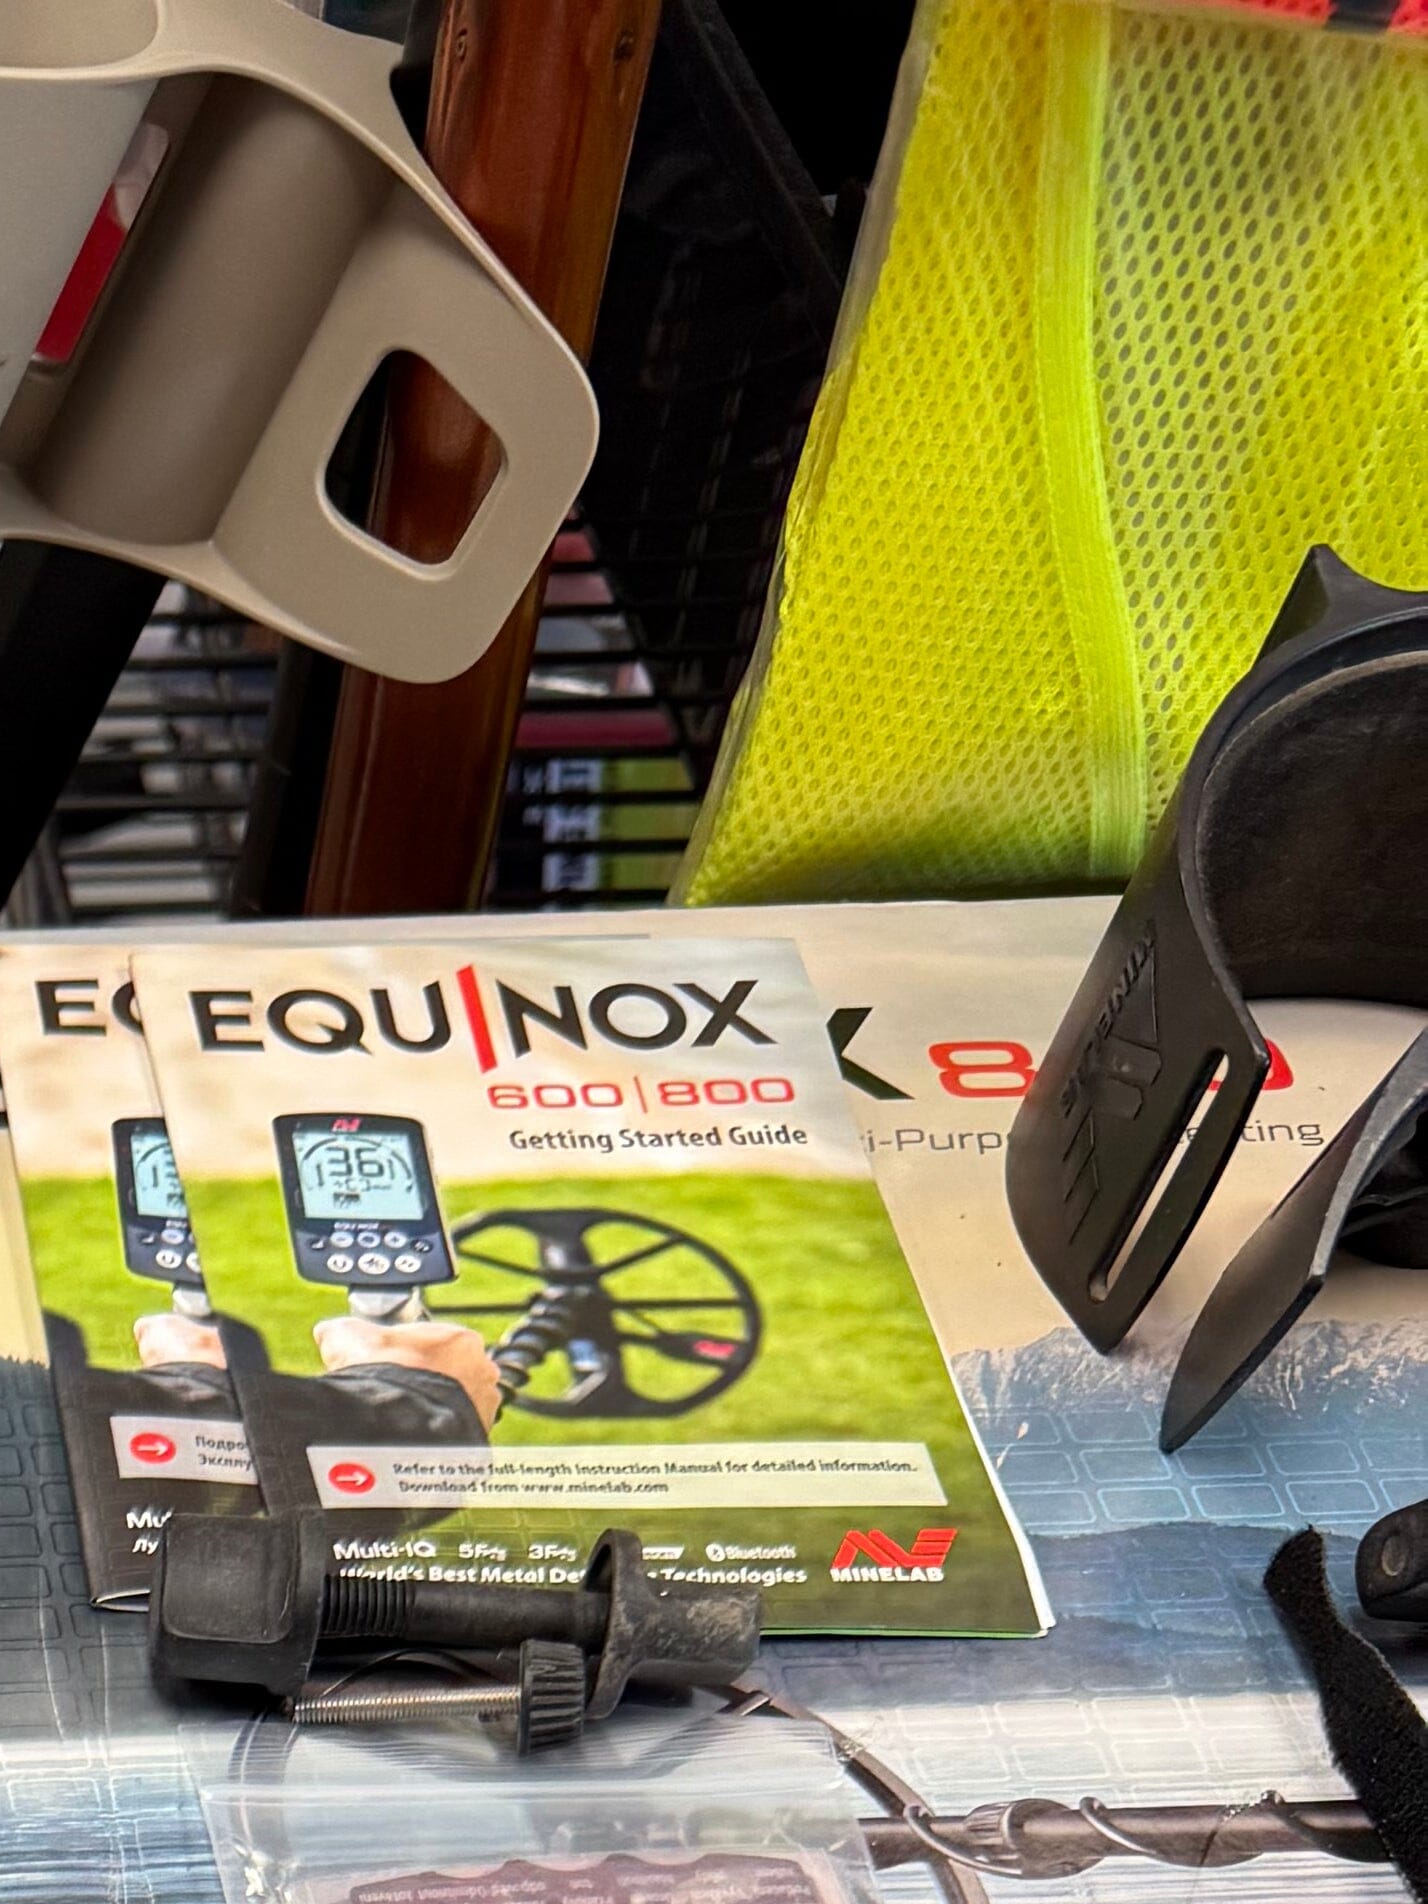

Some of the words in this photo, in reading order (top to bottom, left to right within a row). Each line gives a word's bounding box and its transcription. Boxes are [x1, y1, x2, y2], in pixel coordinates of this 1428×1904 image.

[189, 964, 778, 1074] EQUINOX
[509, 1129, 614, 1153] Getting
[619, 1127, 721, 1149] Started
[728, 1124, 808, 1146] Guide
[393, 1463, 435, 1475] Refer
[438, 1464, 456, 1475] to
[458, 1463, 485, 1475] the
[488, 1462, 572, 1478] full-length
[575, 1461, 661, 1475] Instruction
[664, 1460, 724, 1475] Manual
[726, 1460, 749, 1474] for
[752, 1459, 817, 1474] detailed
[819, 1457, 918, 1473] information.
[398, 1480, 478, 1493] Download
[481, 1480, 519, 1493] from
[520, 1480, 670, 1494] www.minelab.com
[332, 1541, 438, 1561] Multi-IQ
[429, 1566, 477, 1583] Best
[480, 1566, 545, 1584] Metal
[830, 1567, 945, 1583] MINELAB
